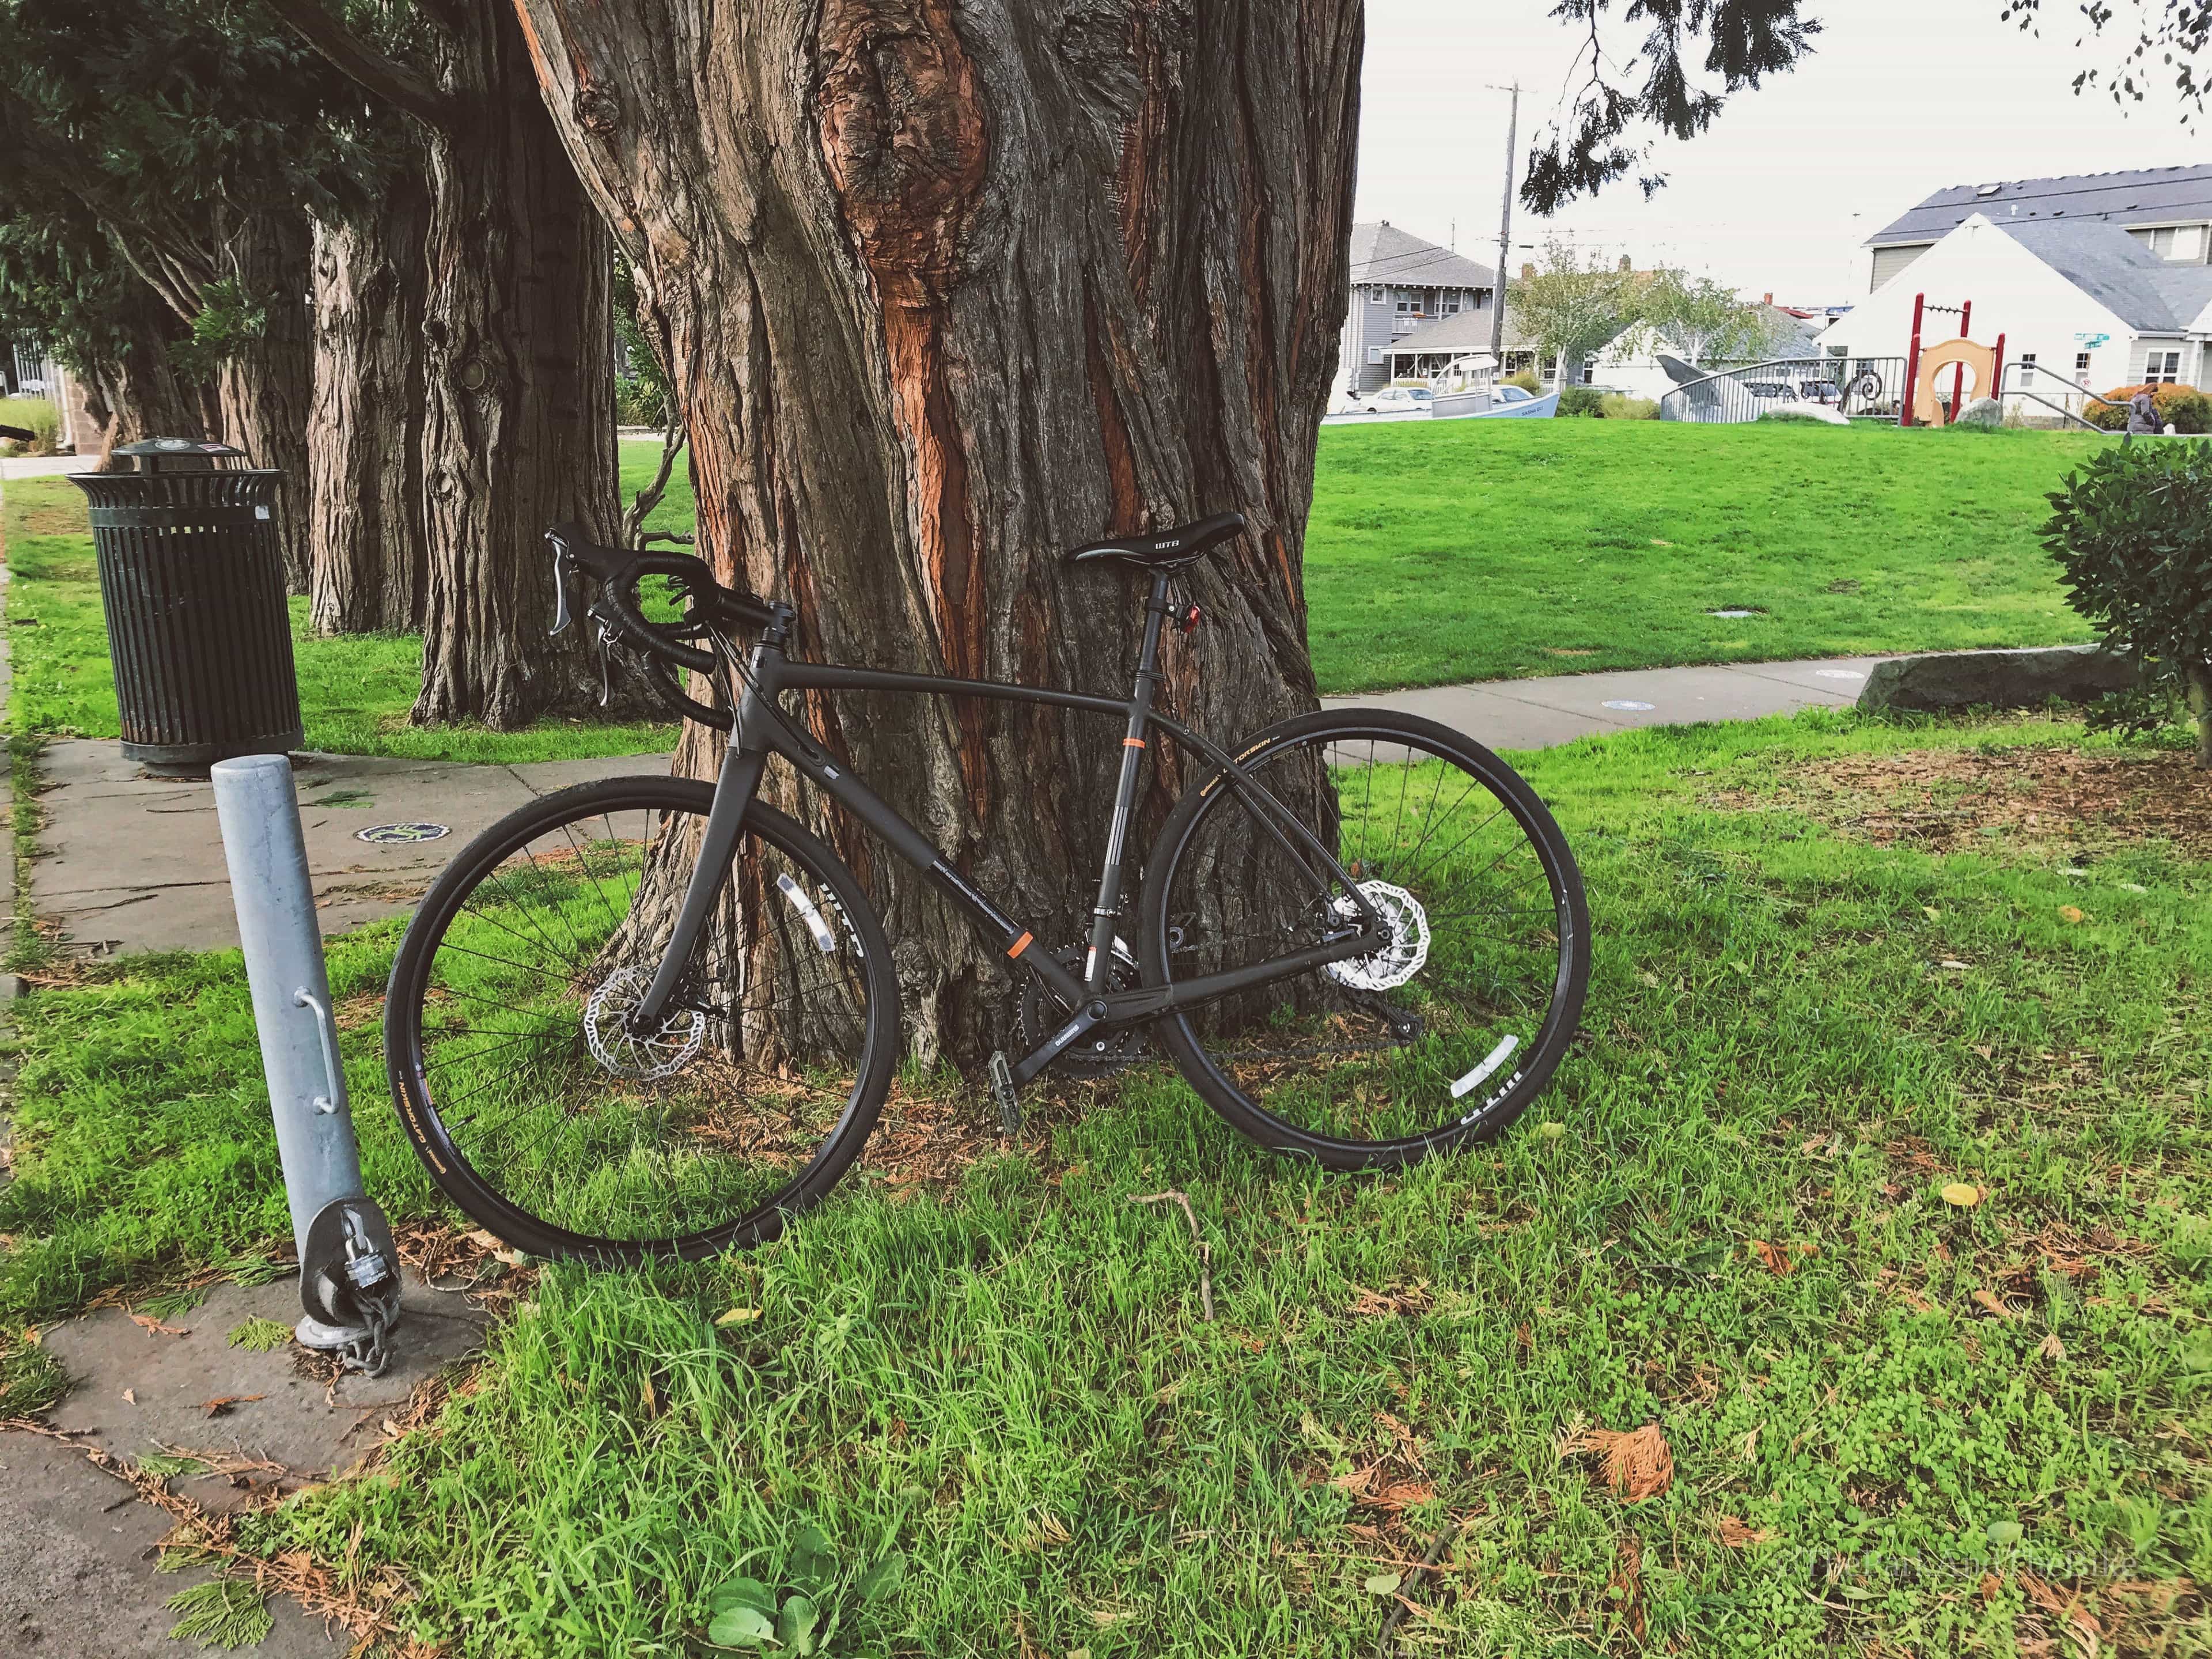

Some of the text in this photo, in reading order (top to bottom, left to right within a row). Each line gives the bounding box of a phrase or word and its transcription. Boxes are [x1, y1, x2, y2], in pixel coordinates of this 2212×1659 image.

[1155, 540, 1180, 550] WTB
[1055, 1024, 1080, 1047] SHIMANO
[398, 1082, 427, 1143] GATORSKIN
